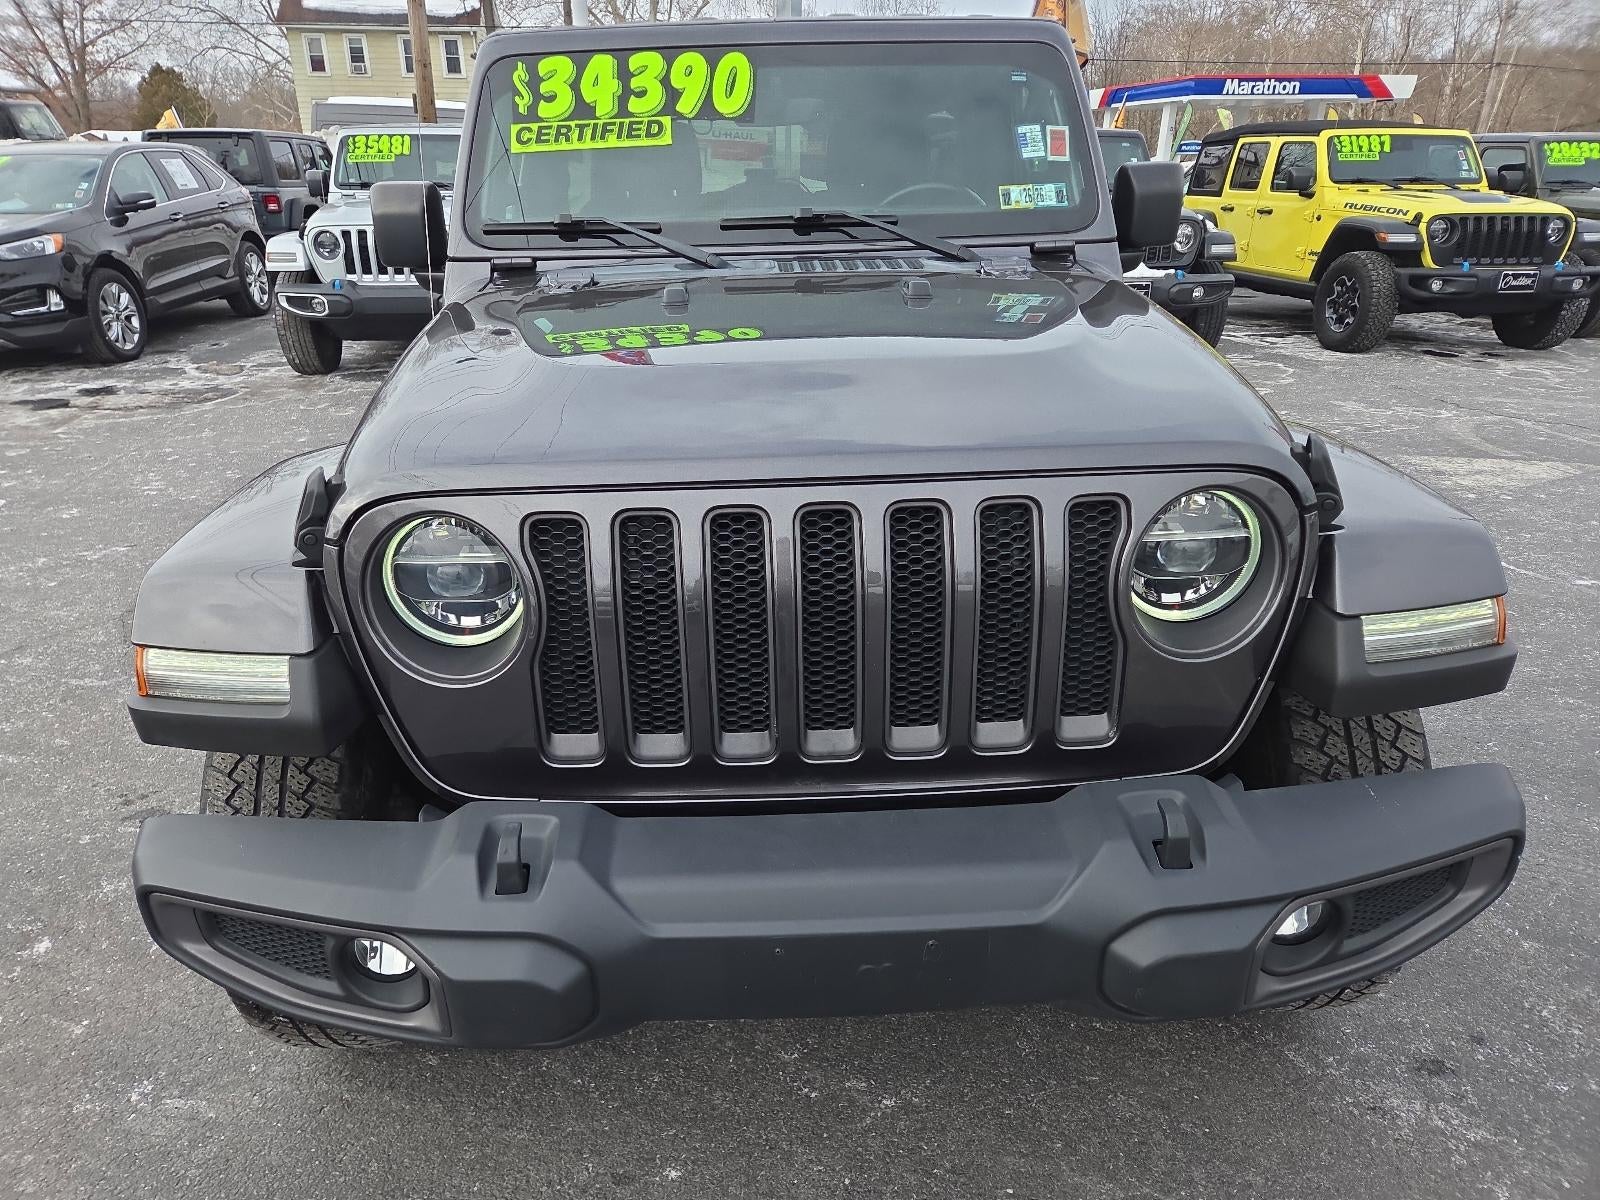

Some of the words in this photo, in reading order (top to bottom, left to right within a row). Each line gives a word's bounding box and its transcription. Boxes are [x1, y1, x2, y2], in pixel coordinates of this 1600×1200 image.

[512, 51, 754, 121] $34390
[1222, 78, 1300, 95] Marathon
[515, 119, 667, 147] CERTIFIED
[348, 134, 411, 156] $35481
[1333, 135, 1391, 152] $31987
[348, 153, 394, 161] CERTIFIED
[1344, 202, 1409, 216] RUBICON
